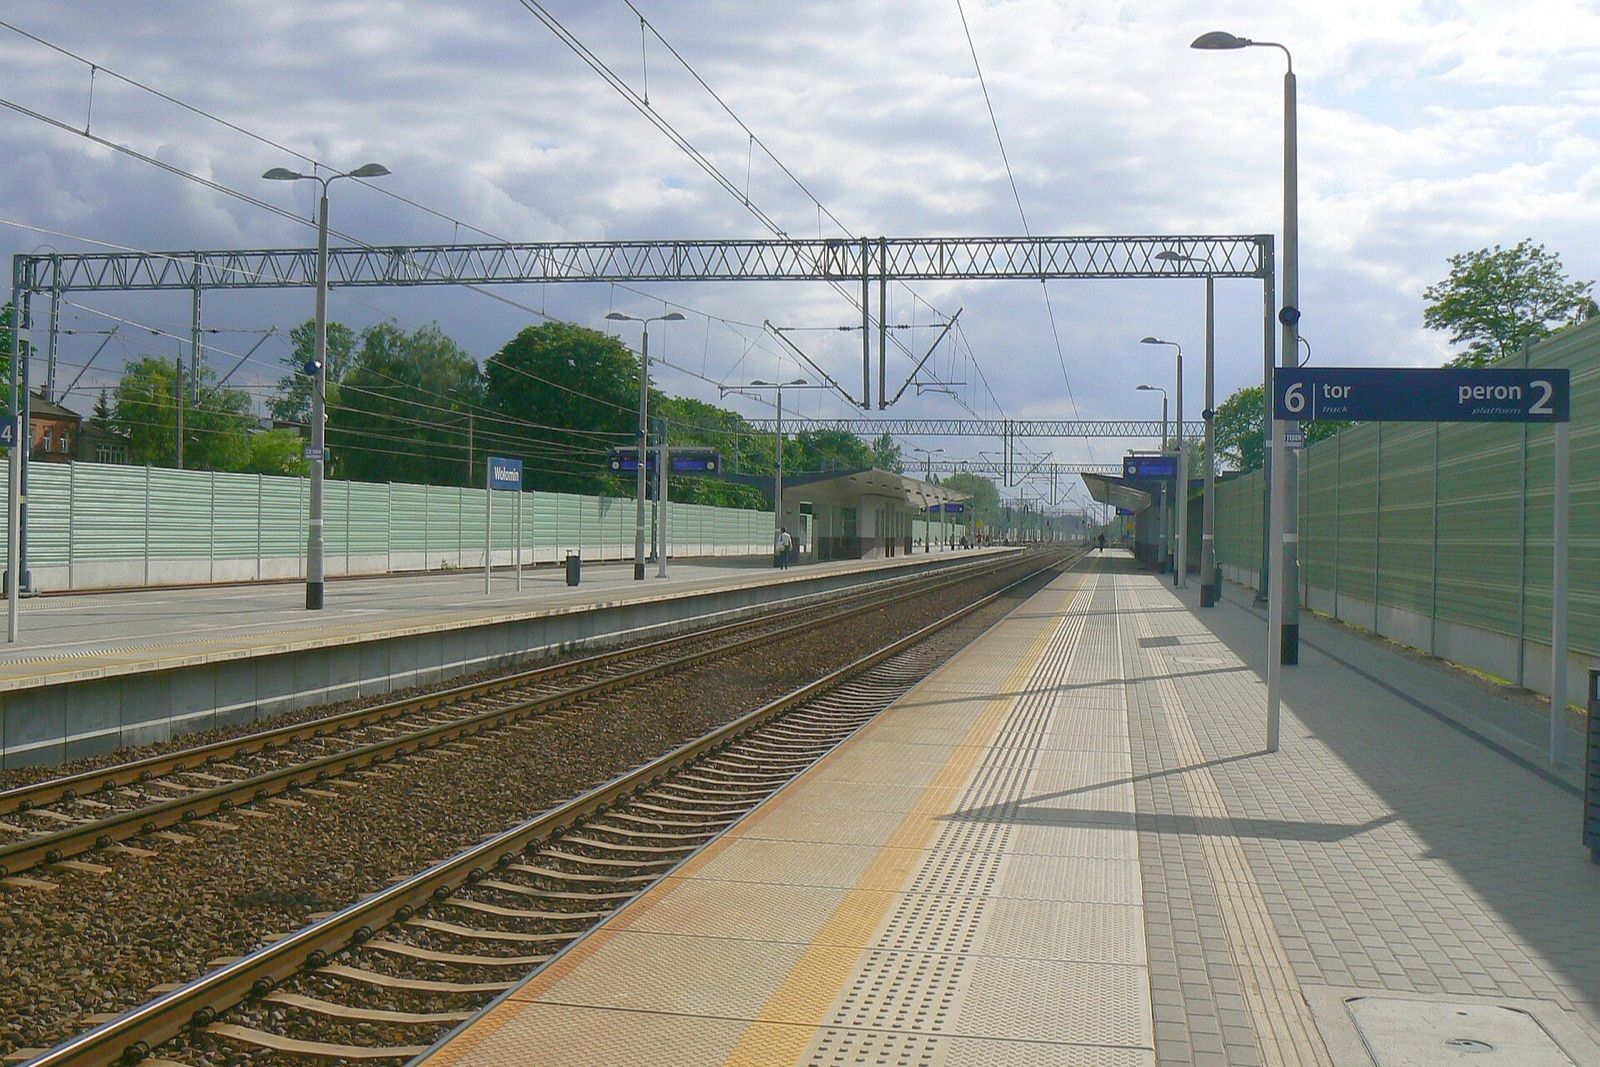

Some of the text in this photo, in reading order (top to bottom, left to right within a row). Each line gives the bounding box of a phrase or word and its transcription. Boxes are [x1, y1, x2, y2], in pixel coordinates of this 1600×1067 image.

[1284, 382, 1351, 413] 6 tor
[1458, 380, 1553, 414] peron 2
[1472, 407, 1521, 415] platform
[1, 425, 12, 443] 4
